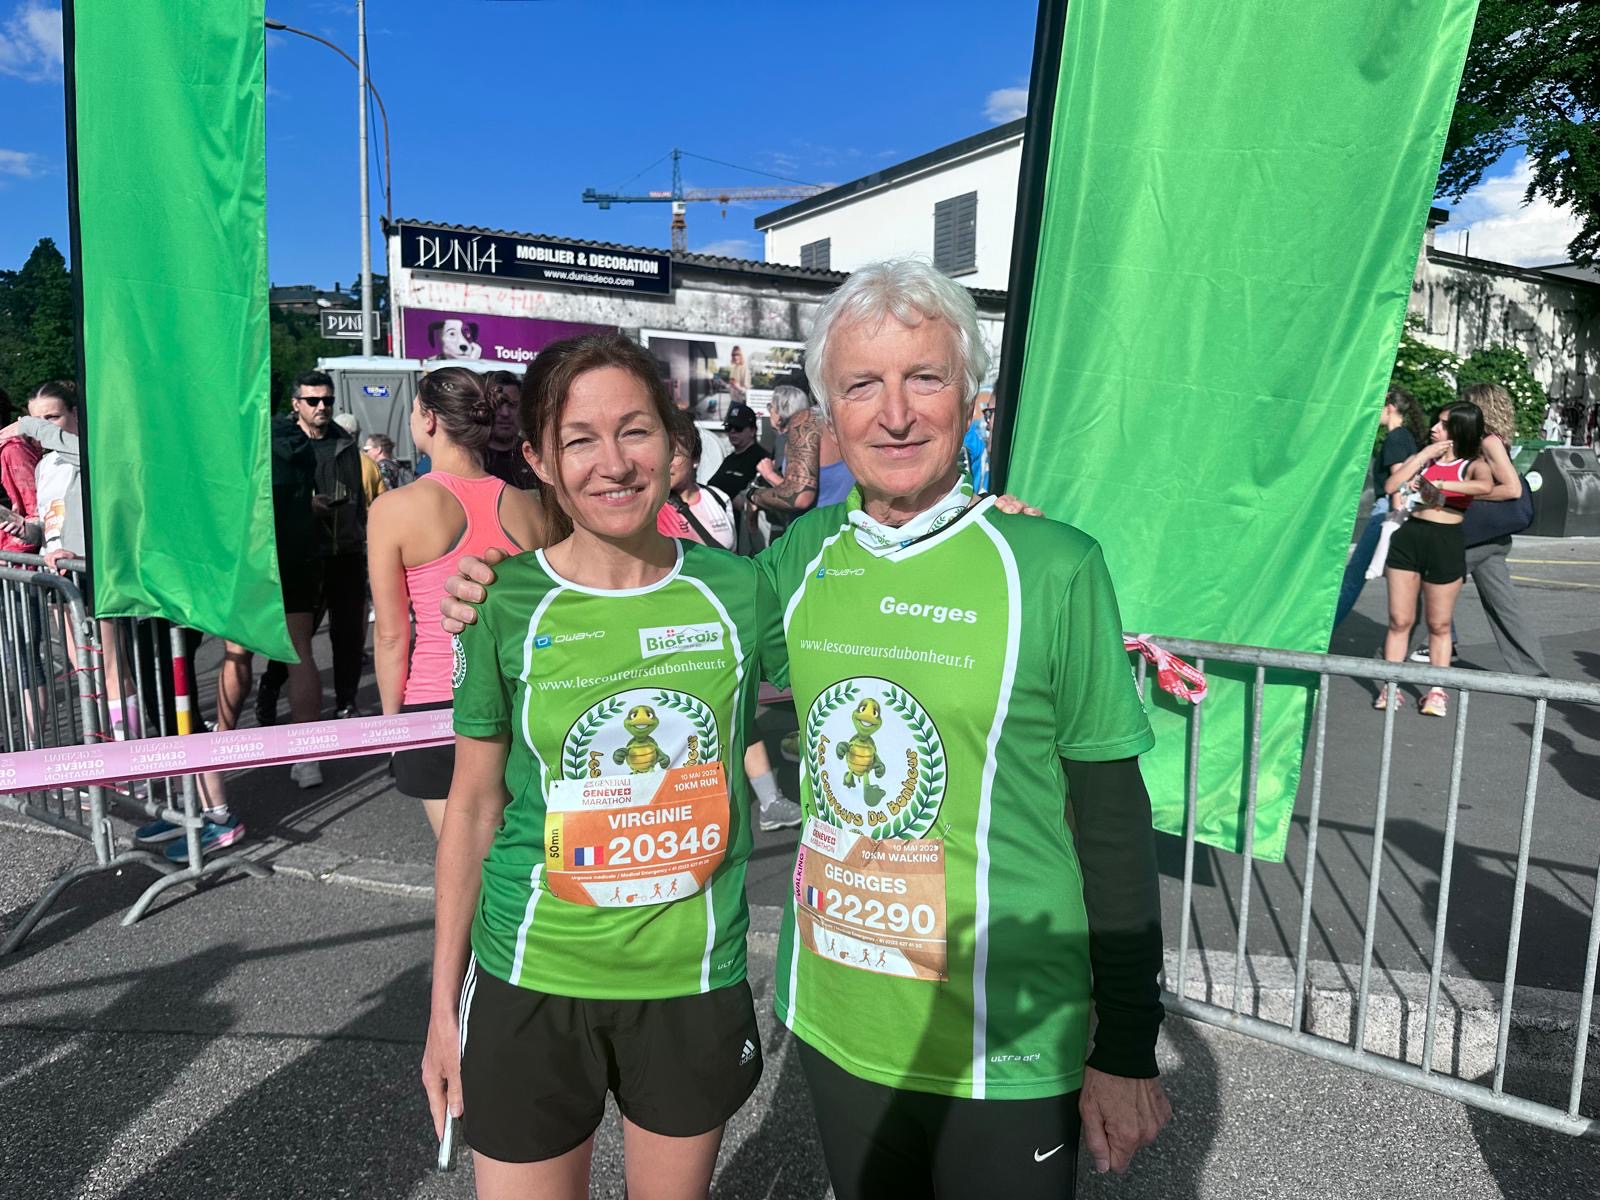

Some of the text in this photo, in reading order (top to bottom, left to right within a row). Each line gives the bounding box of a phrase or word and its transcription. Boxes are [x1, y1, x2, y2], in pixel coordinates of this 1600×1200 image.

[516, 245, 658, 274] MOBILIER & DECORATION
[544, 270, 634, 287] www.duniadeco.com
[880, 596, 978, 624] Georges
[646, 630, 719, 651] BioFrais
[800, 638, 975, 669] www.lescoureursdubonheur.fr
[538, 659, 727, 691] www.lescoureursdubonheur.fr
[674, 777, 718, 792] 10KM RUN
[689, 771, 700, 779] MAI
[820, 770, 864, 826] Coureurs
[867, 811, 888, 826] Du
[887, 748, 919, 816] Bonheur
[582, 796, 632, 806] MARATHON
[608, 805, 693, 830] VIRGINIE
[550, 828, 560, 859] 50mn
[608, 823, 721, 866] 20346
[888, 853, 938, 863] WALKING
[795, 852, 804, 897] WALKING
[824, 863, 907, 894] GEORGES
[825, 888, 936, 935] 22290
